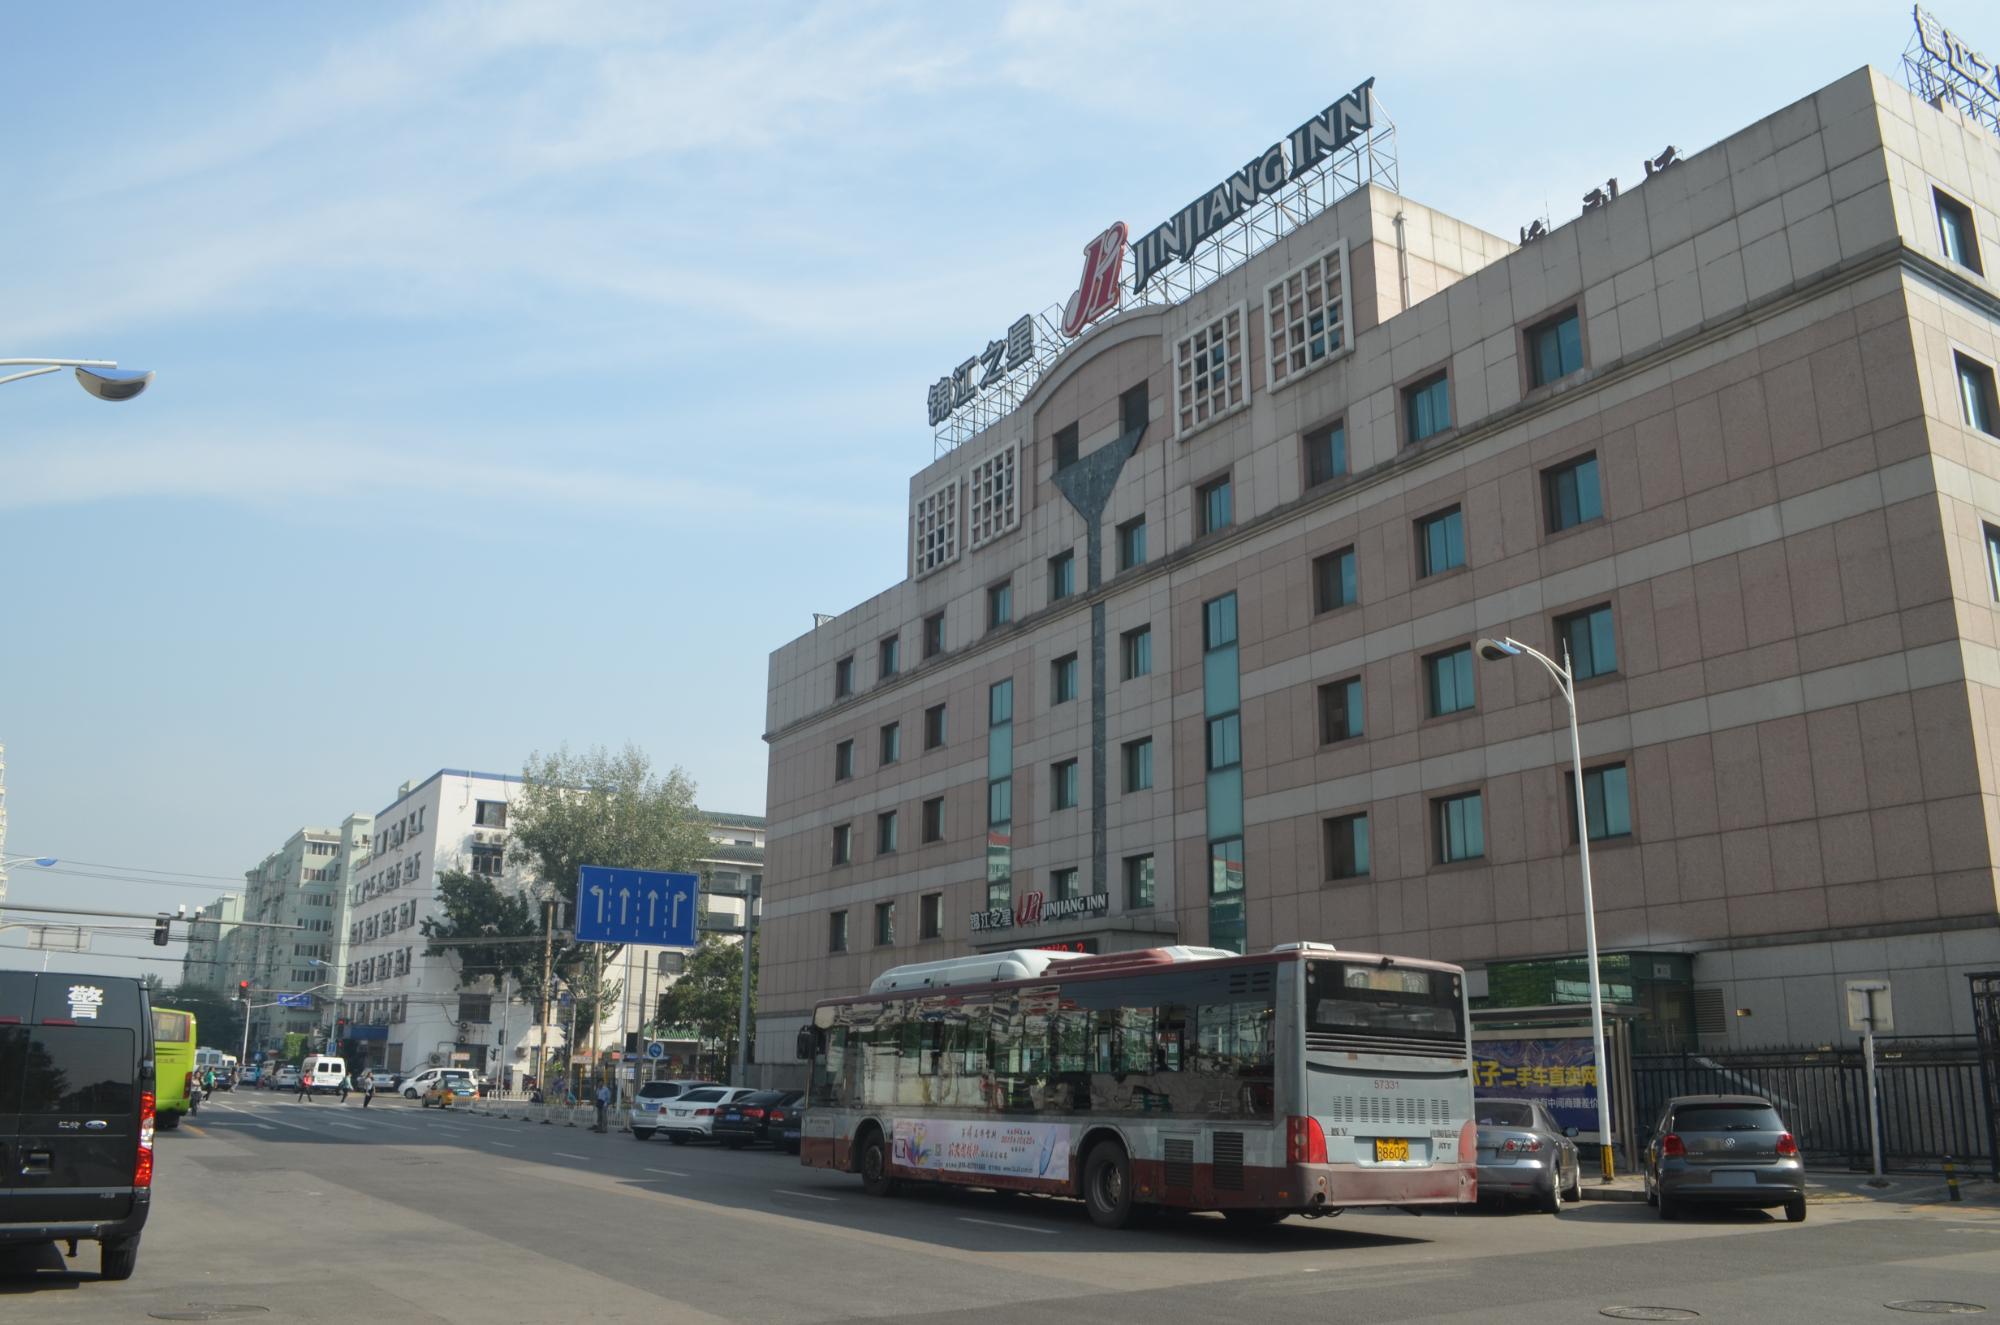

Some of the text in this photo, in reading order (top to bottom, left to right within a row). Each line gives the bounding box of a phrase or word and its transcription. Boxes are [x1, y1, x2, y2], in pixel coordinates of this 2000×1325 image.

[1132, 141, 1288, 295] JINJIANG
[1287, 76, 1376, 182] INN
[927, 313, 1035, 427] 锦江之星
[969, 907, 1013, 931] 锦江之星
[1042, 897, 1085, 921] JINJIANG
[1087, 892, 1108, 910] INN
[68, 985, 104, 1019] 警
